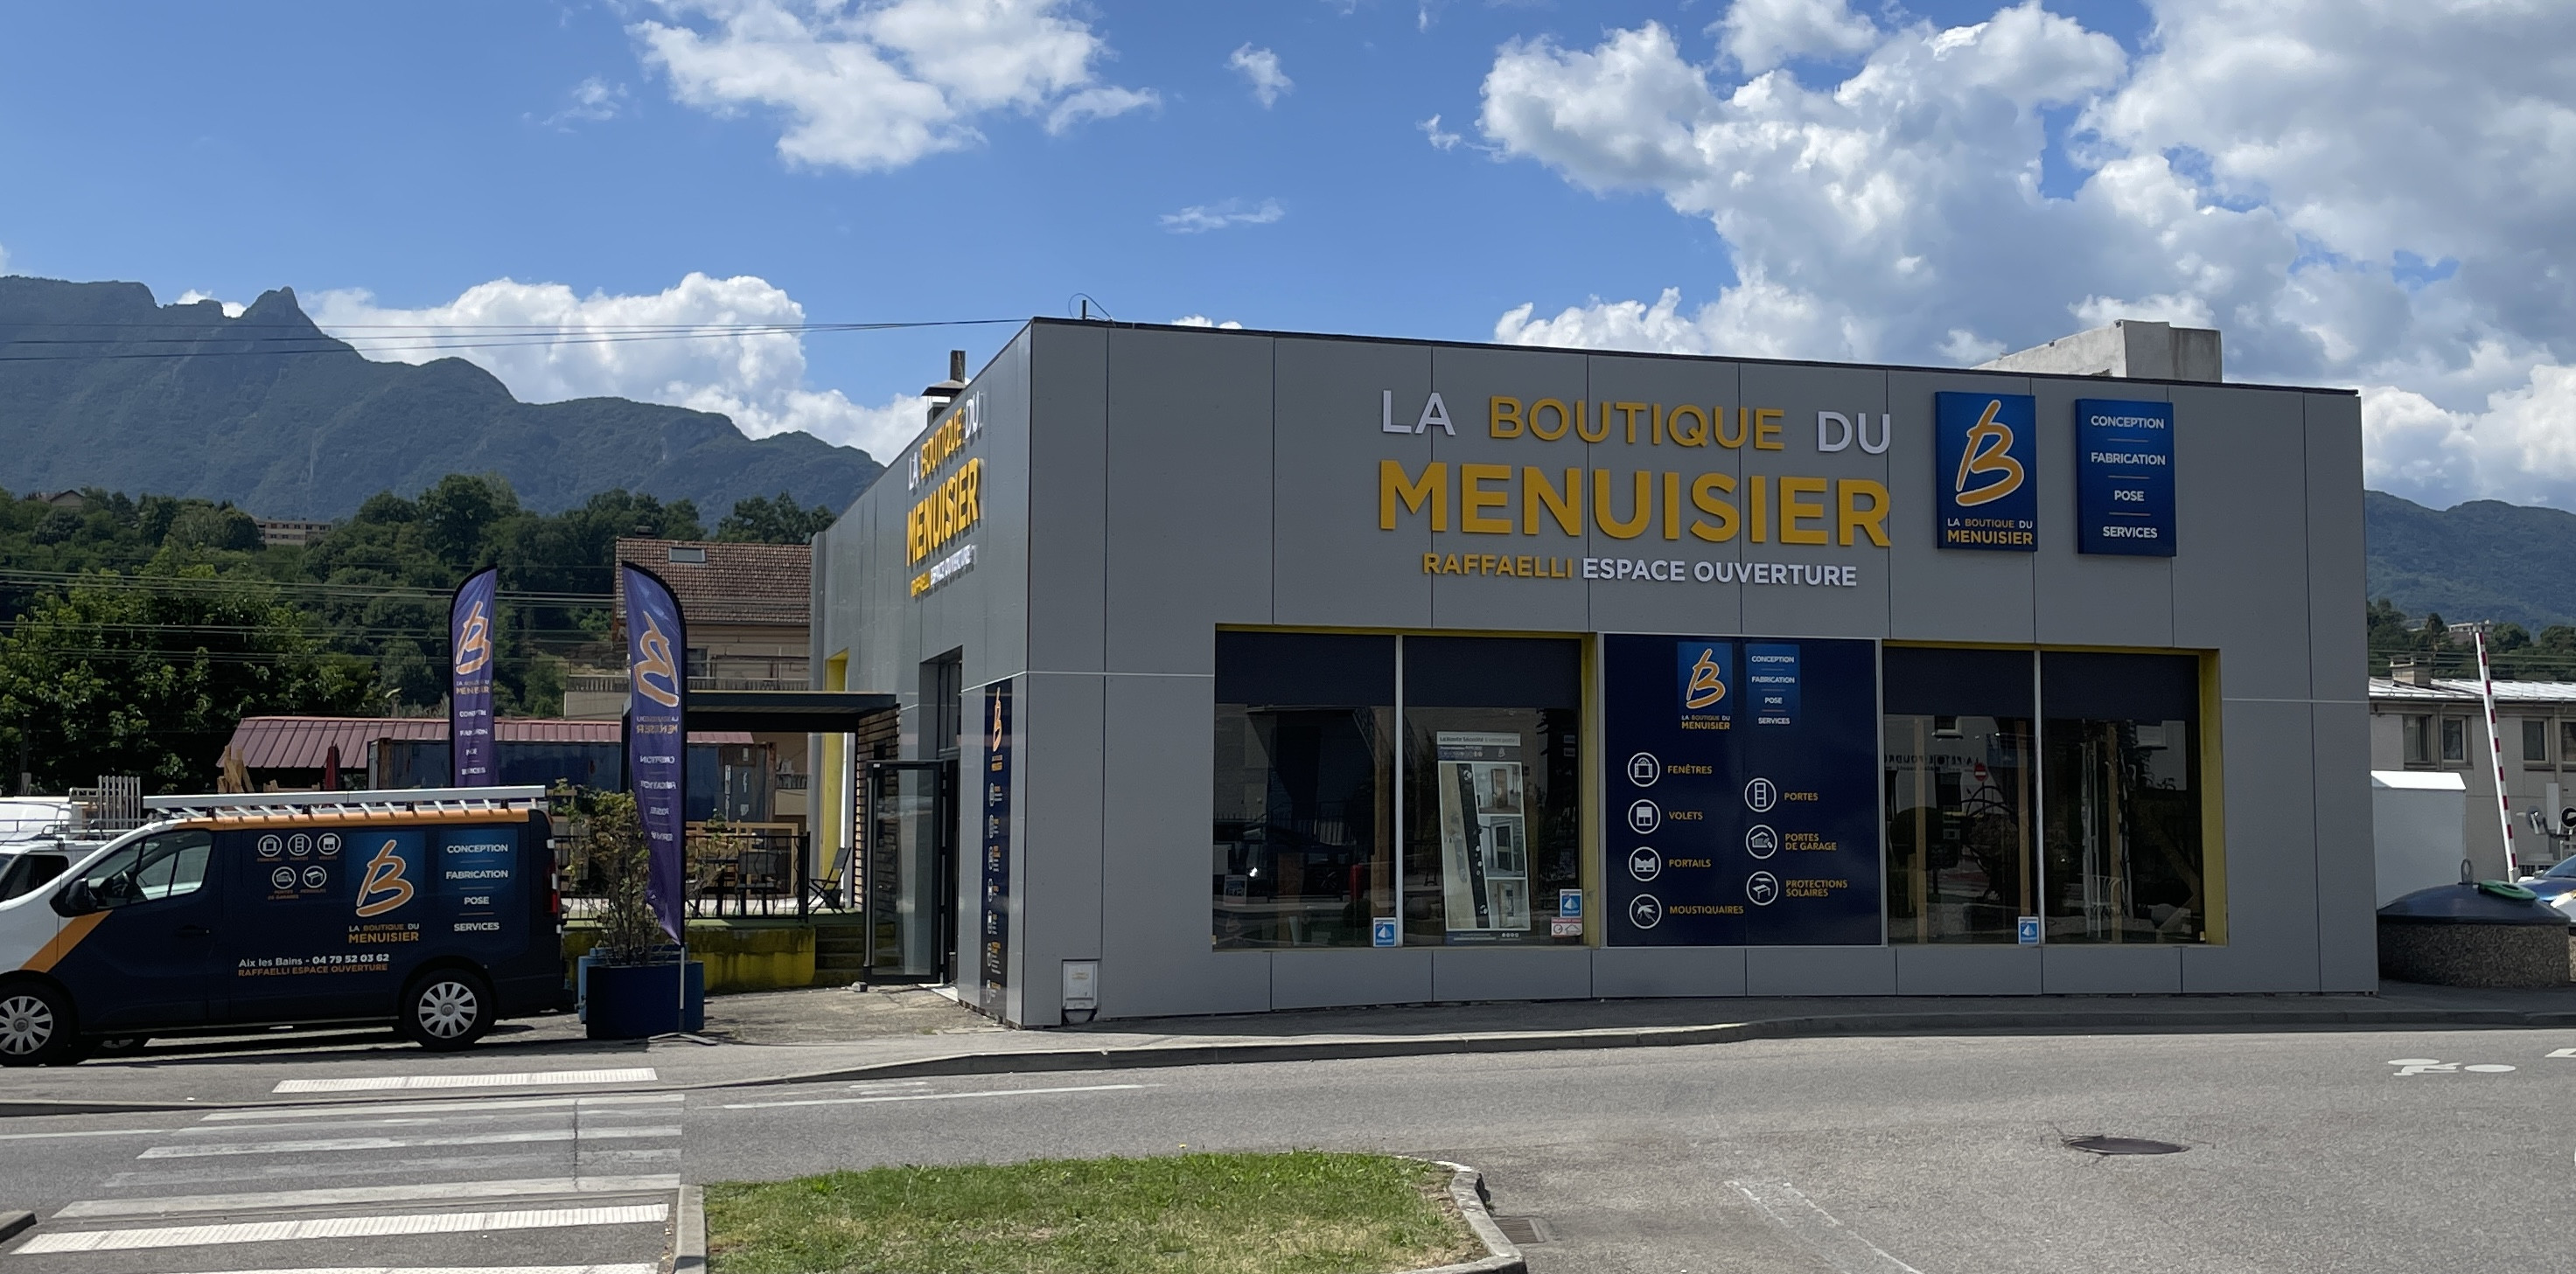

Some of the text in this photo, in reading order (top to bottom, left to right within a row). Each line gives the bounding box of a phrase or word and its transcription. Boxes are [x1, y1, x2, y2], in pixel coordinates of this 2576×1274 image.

[1382, 390, 1891, 454] LA BOUTIQUE DU
[2091, 415, 2165, 429] CONCEPTION
[908, 451, 918, 491] LA
[920, 407, 963, 480] BOUTIQUE
[2091, 451, 2166, 466] FABRICATION
[2114, 490, 2145, 502] POSE
[1379, 460, 1891, 546] MENUISIER
[906, 457, 979, 567] MENUISIER
[1947, 517, 2033, 530] LA BOUTIQUE DU
[1947, 530, 2033, 545] MENUISIER
[2103, 526, 2158, 539] SERVICES
[1422, 553, 1857, 587] RAFFAELLI ESPACE OUVERTURE
[1751, 655, 1794, 664] CONCEPTION
[1681, 721, 1730, 730] MENUISIER
[1667, 763, 1713, 775] FENÊTRES
[1784, 792, 1819, 802] PORTES
[1668, 811, 1703, 821] VOLETS
[1784, 833, 1819, 842] PORTES
[446, 843, 508, 854] CONCEPTION
[1784, 842, 1837, 852] DE GARAGE
[1668, 859, 1711, 867] PORTAILS
[445, 868, 509, 881] FABRICATION
[1785, 880, 1847, 888] PROTECTIONS
[1785, 888, 1829, 898] SOLAIRES
[464, 895, 490, 906] POSE
[1669, 905, 1744, 915] MOUSTIQUAIRES
[363, 923, 404, 932] BOUTIQUE
[453, 921, 500, 933] SERVICES
[348, 930, 420, 944] MENUISIER
[238, 958, 255, 968] Aix
[258, 957, 272, 966] les
[276, 956, 303, 966] Bains
[311, 956, 326, 964] 04
[329, 955, 343, 964] 79
[345, 954, 358, 964] 52
[360, 953, 373, 963] 03
[376, 953, 389, 962] 62
[238, 963, 388, 977] RAFFAELLI ESPACE OUVERTURE
